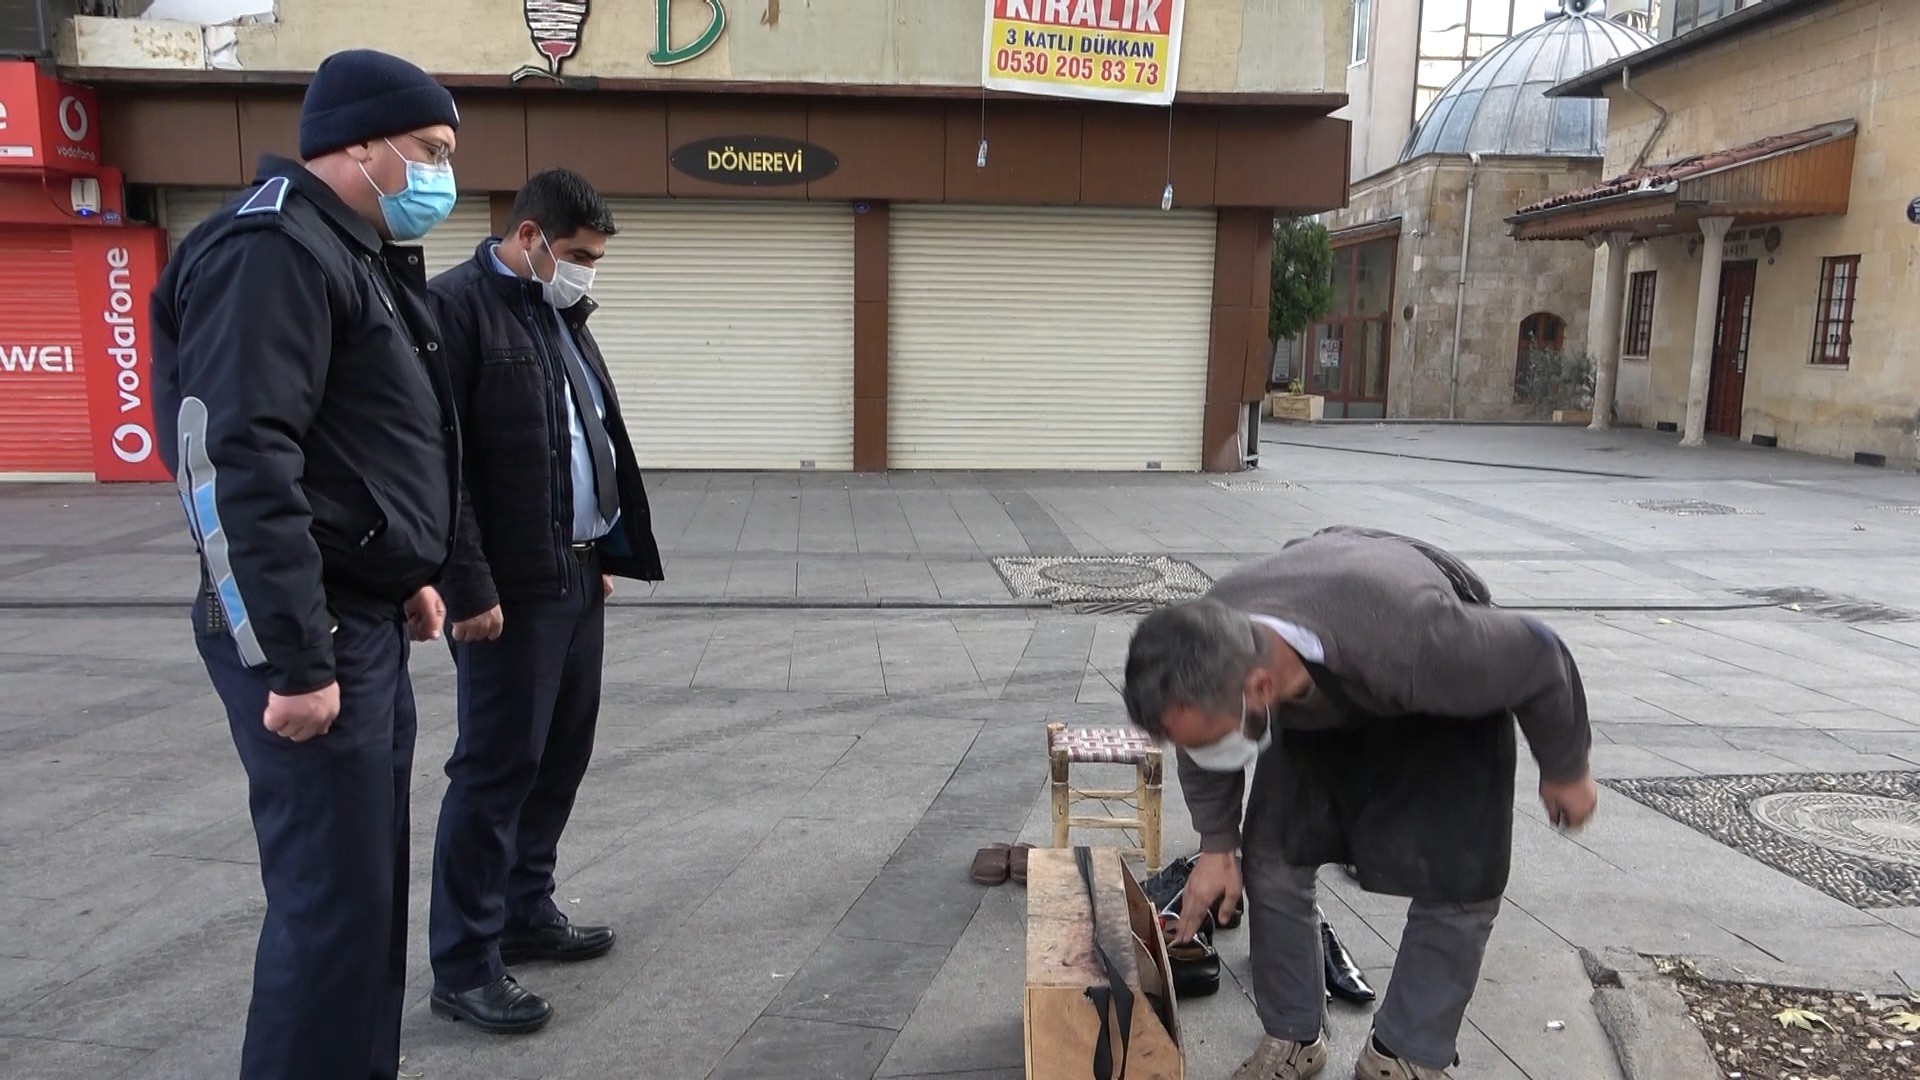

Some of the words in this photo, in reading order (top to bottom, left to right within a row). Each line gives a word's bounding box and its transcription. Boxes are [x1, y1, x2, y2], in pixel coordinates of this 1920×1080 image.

[1006, 28, 1017, 46] 3
[1024, 30, 1073, 51] KATLI
[1081, 34, 1154, 59] DÜKKAN
[996, 48, 1048, 75] 0530
[1055, 55, 1093, 80] 205
[1101, 59, 1126, 83] 83
[1134, 61, 1159, 85] 73
[708, 146, 803, 173] DÖNEREVİ
[104, 247, 140, 413] vodafone
[0, 345, 73, 372] WEI
